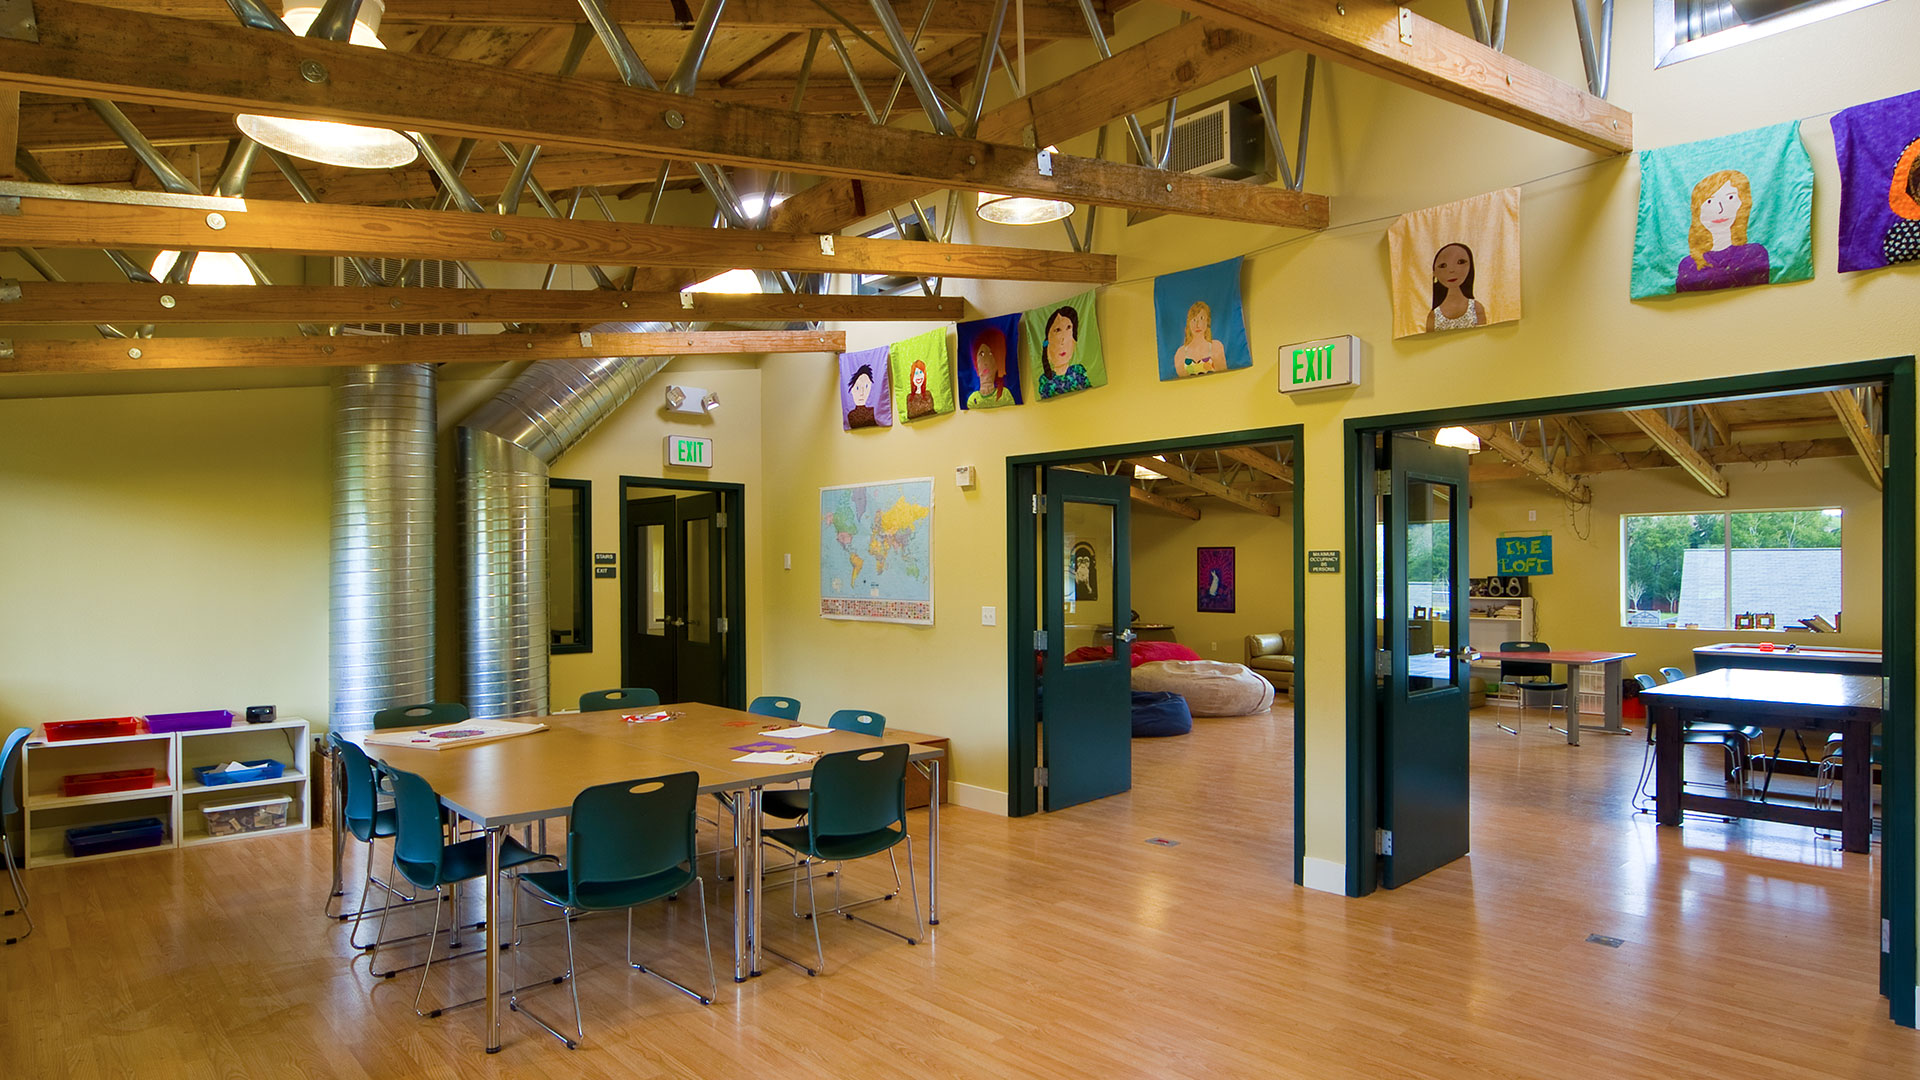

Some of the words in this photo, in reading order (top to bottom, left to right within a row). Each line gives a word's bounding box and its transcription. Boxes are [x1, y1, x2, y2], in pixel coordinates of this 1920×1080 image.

[1292, 344, 1335, 385] EXIT
[678, 440, 704, 463] EXIT
[1501, 557, 1549, 573] LOFT
